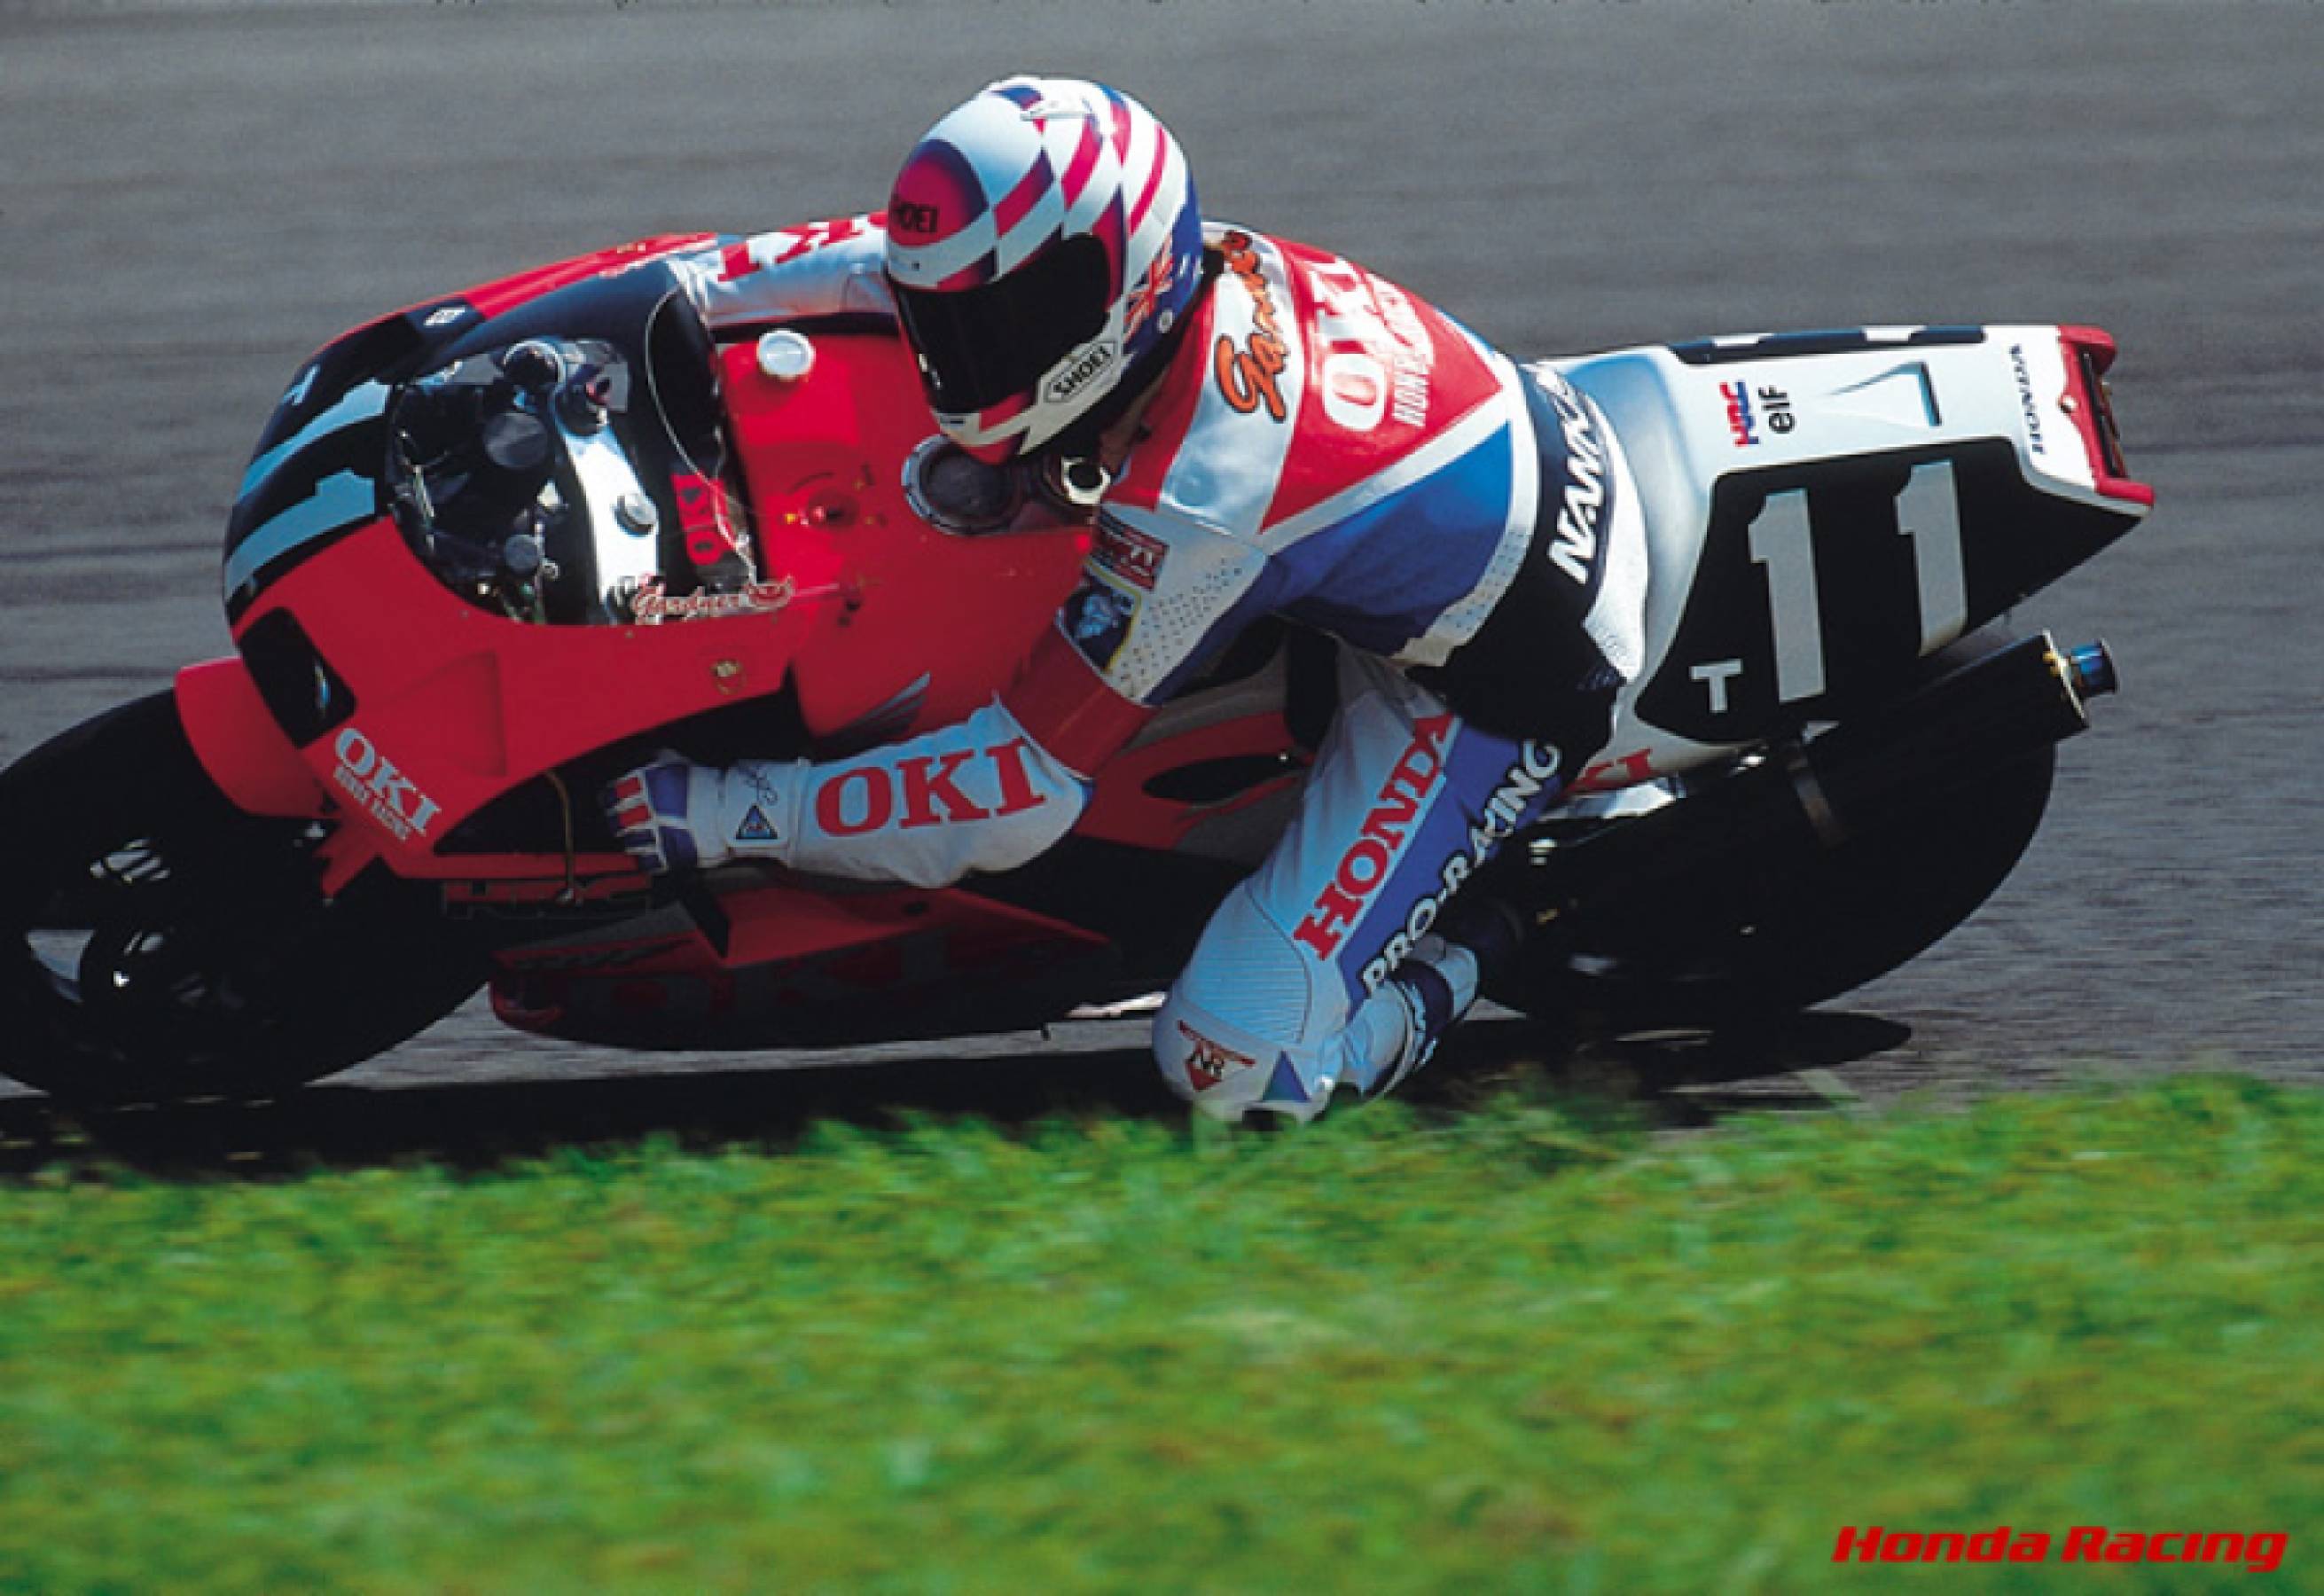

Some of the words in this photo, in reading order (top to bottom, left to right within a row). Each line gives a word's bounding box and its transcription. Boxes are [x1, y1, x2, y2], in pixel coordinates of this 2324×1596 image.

[1052, 344, 1111, 395] SHOEI
[1719, 380, 1760, 448] HRC
[1747, 458, 1968, 703] 11
[1690, 658, 1743, 713] T
[335, 728, 442, 836] OKI
[815, 737, 1047, 838] OKI
[1292, 711, 1457, 962] HONDA
[1361, 738, 1561, 996] PRO-RACING
